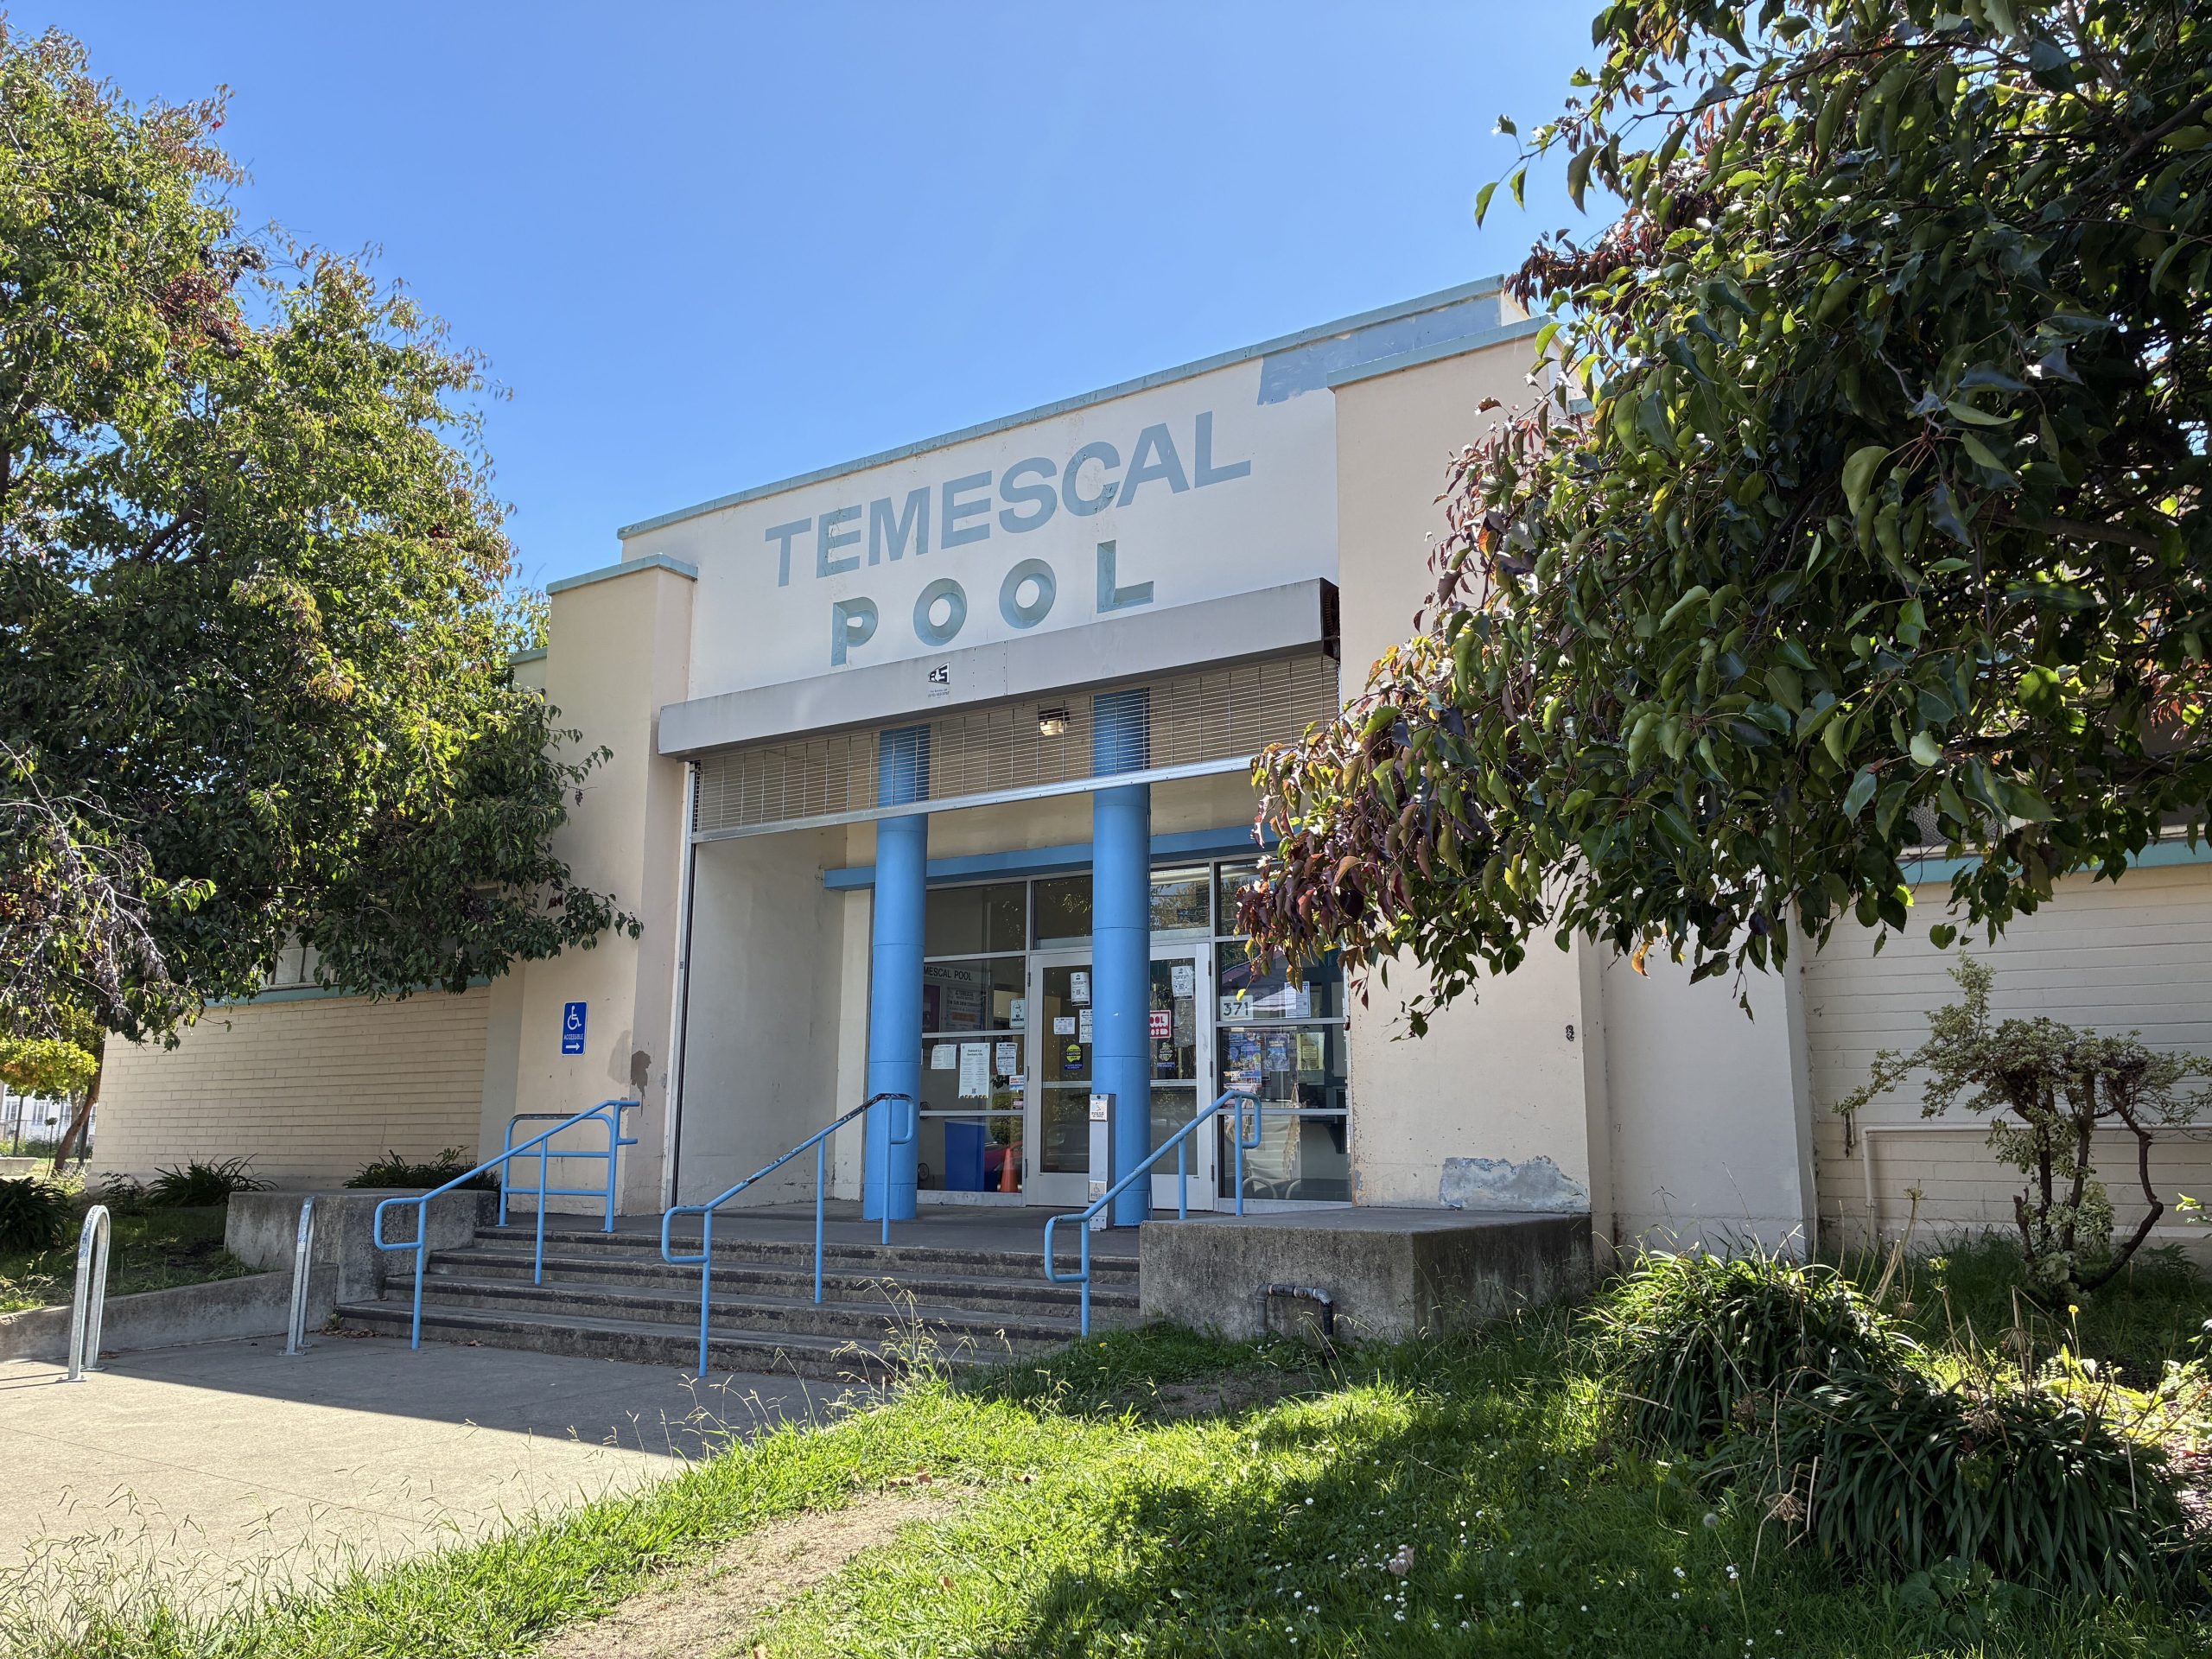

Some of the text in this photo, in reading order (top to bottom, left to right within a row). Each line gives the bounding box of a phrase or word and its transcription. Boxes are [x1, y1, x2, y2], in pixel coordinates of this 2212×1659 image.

[764, 410, 1251, 588] TEMESCAL
[830, 539, 1154, 667] POOL
[924, 965, 972, 981] MESCAL POOL
[1223, 1001, 1249, 1016] 371
[1149, 1015, 1165, 1024] OOL
